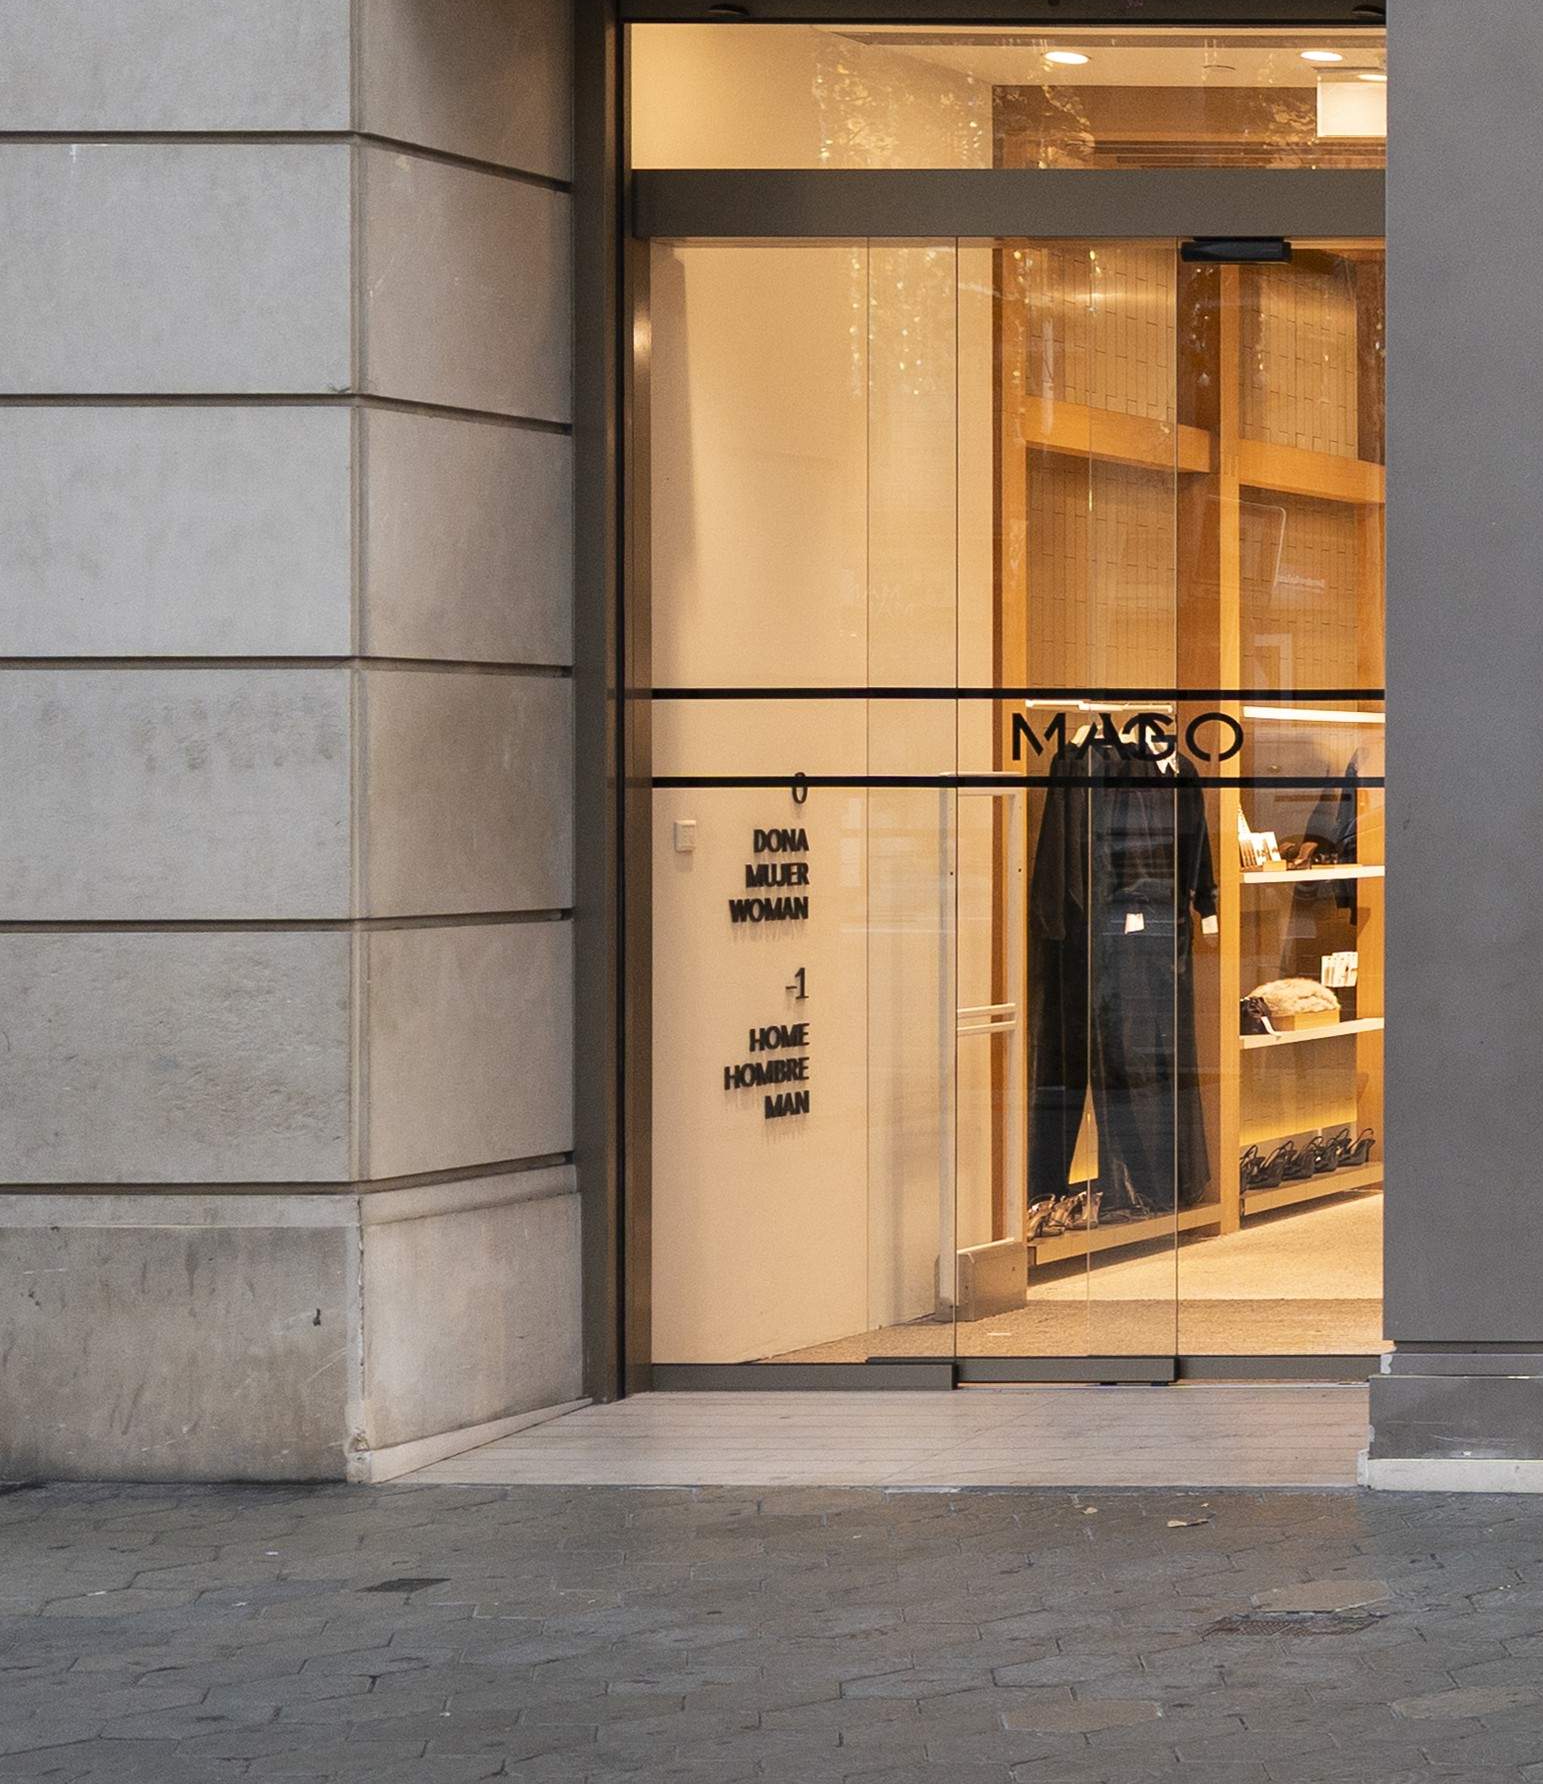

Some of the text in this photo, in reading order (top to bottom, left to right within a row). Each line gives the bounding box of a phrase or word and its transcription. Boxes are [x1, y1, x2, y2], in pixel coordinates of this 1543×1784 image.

[753, 828, 810, 854] DONA
[744, 862, 811, 889] MUJER
[728, 896, 810, 924] WOMAN
[785, 967, 810, 1000] -1
[749, 1023, 810, 1052] HOME
[724, 1057, 810, 1091] HOMBRE
[764, 1090, 810, 1120] MAN
